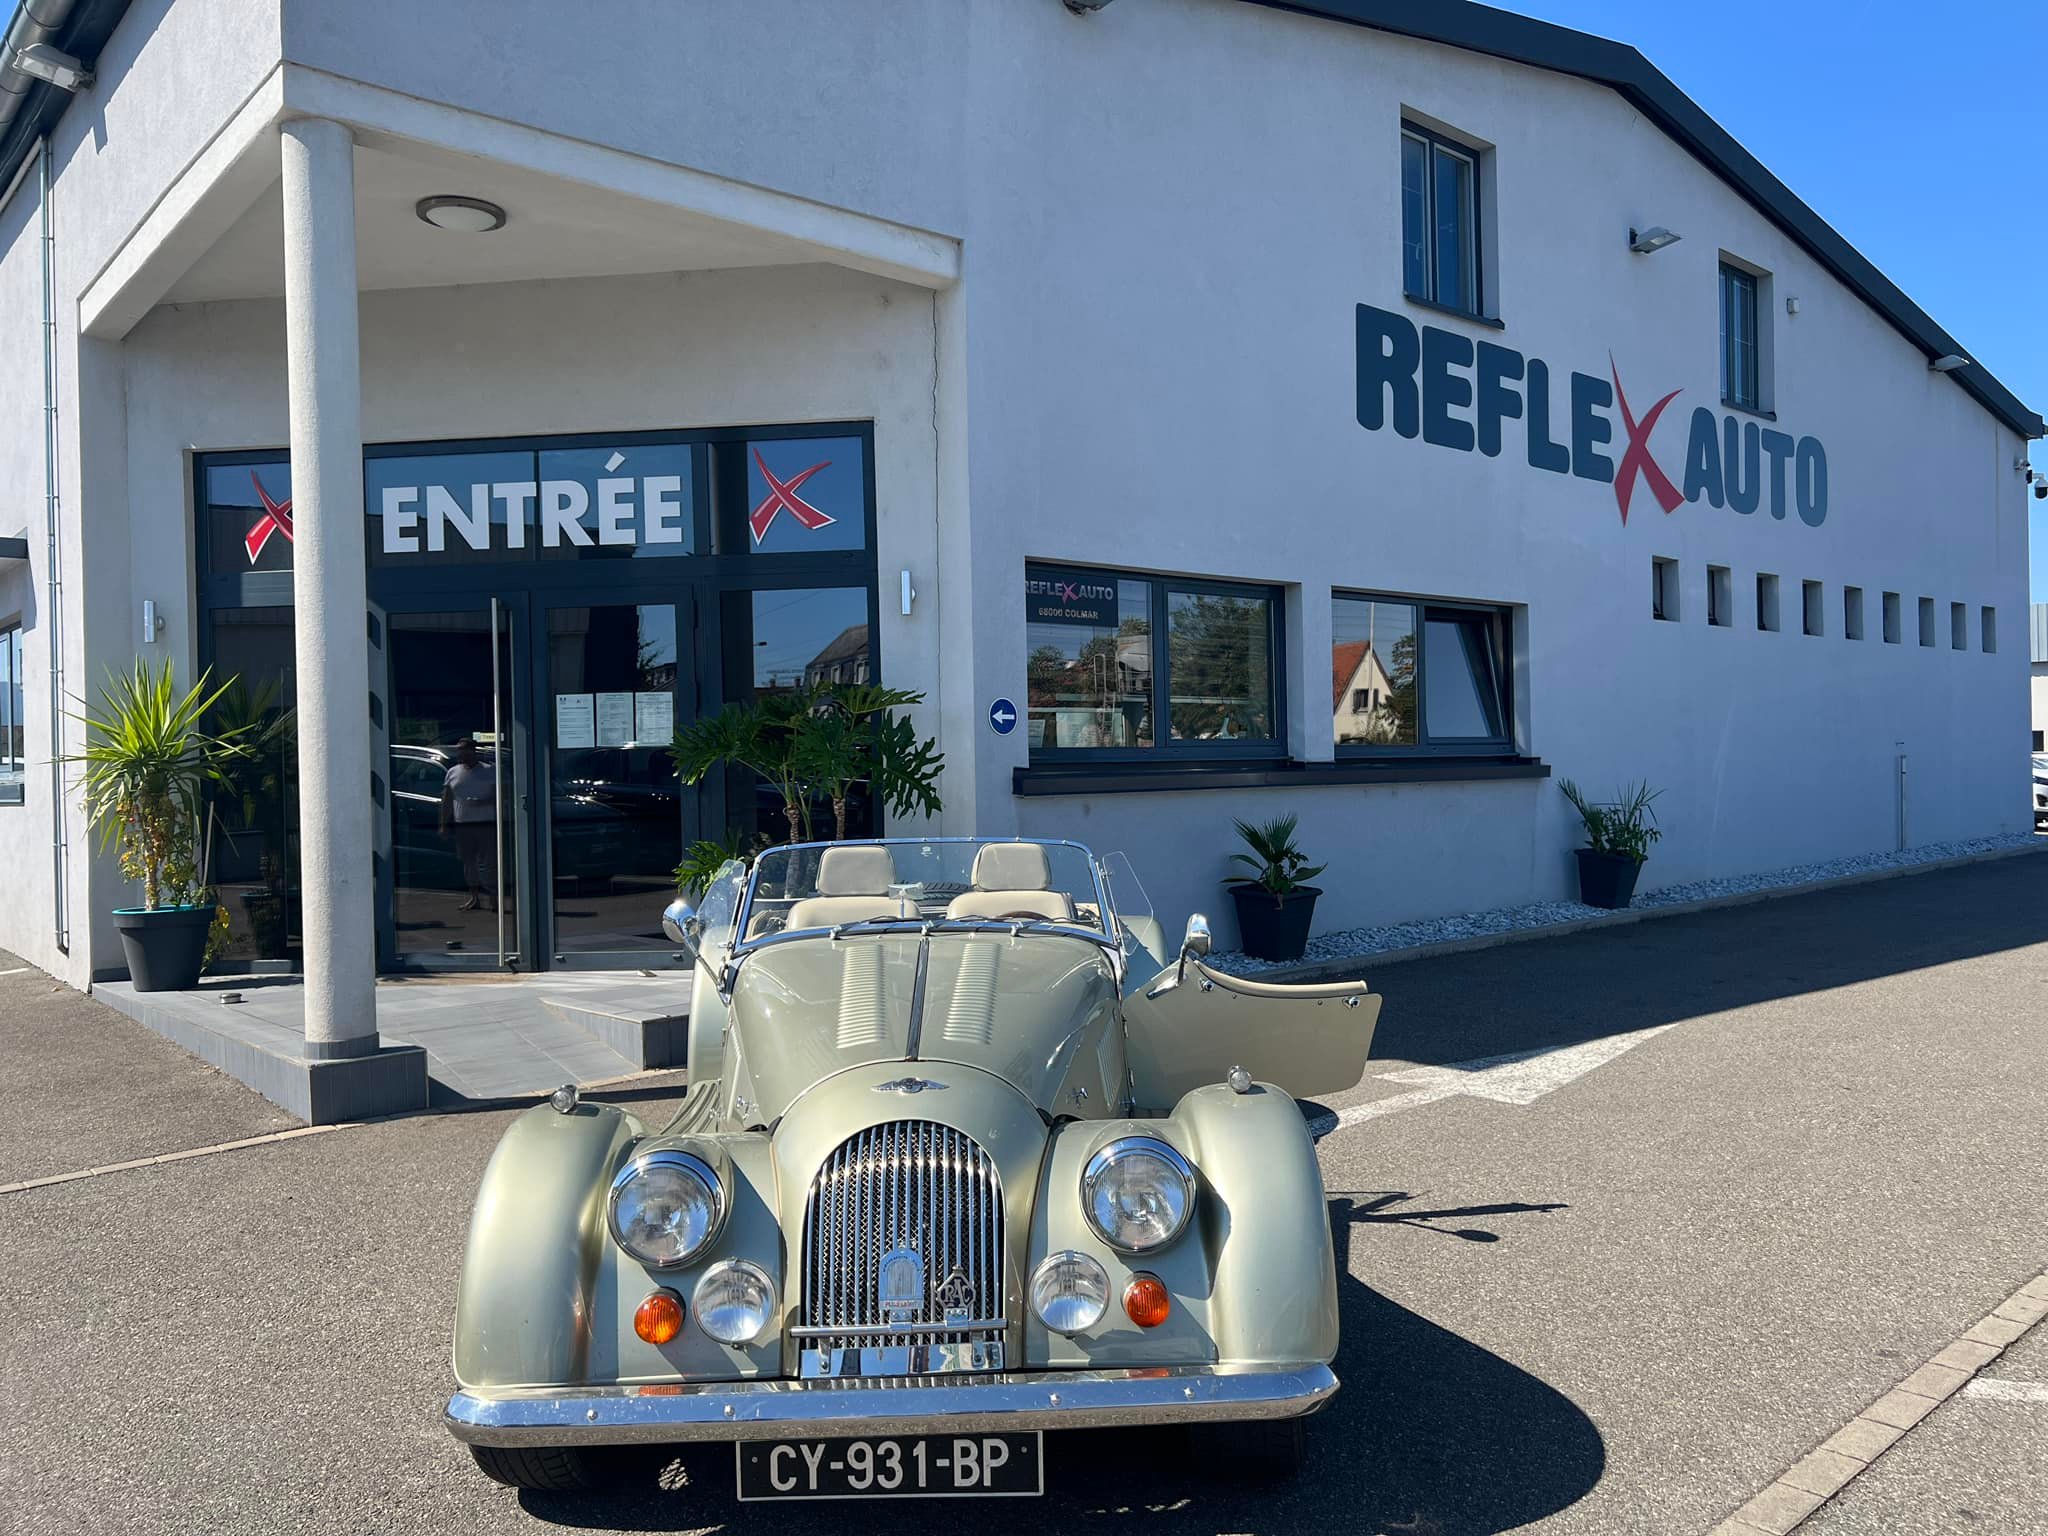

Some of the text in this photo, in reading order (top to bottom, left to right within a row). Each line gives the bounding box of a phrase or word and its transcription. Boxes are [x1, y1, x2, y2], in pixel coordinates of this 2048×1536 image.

[1356, 302, 1828, 528] REFLEX AUTO
[382, 451, 682, 553] ENTRÉE
[1038, 607, 1099, 619] 68000 COLMAR
[1079, 585, 1113, 600] AUTO
[769, 1438, 1010, 1492] CY-931-BP
